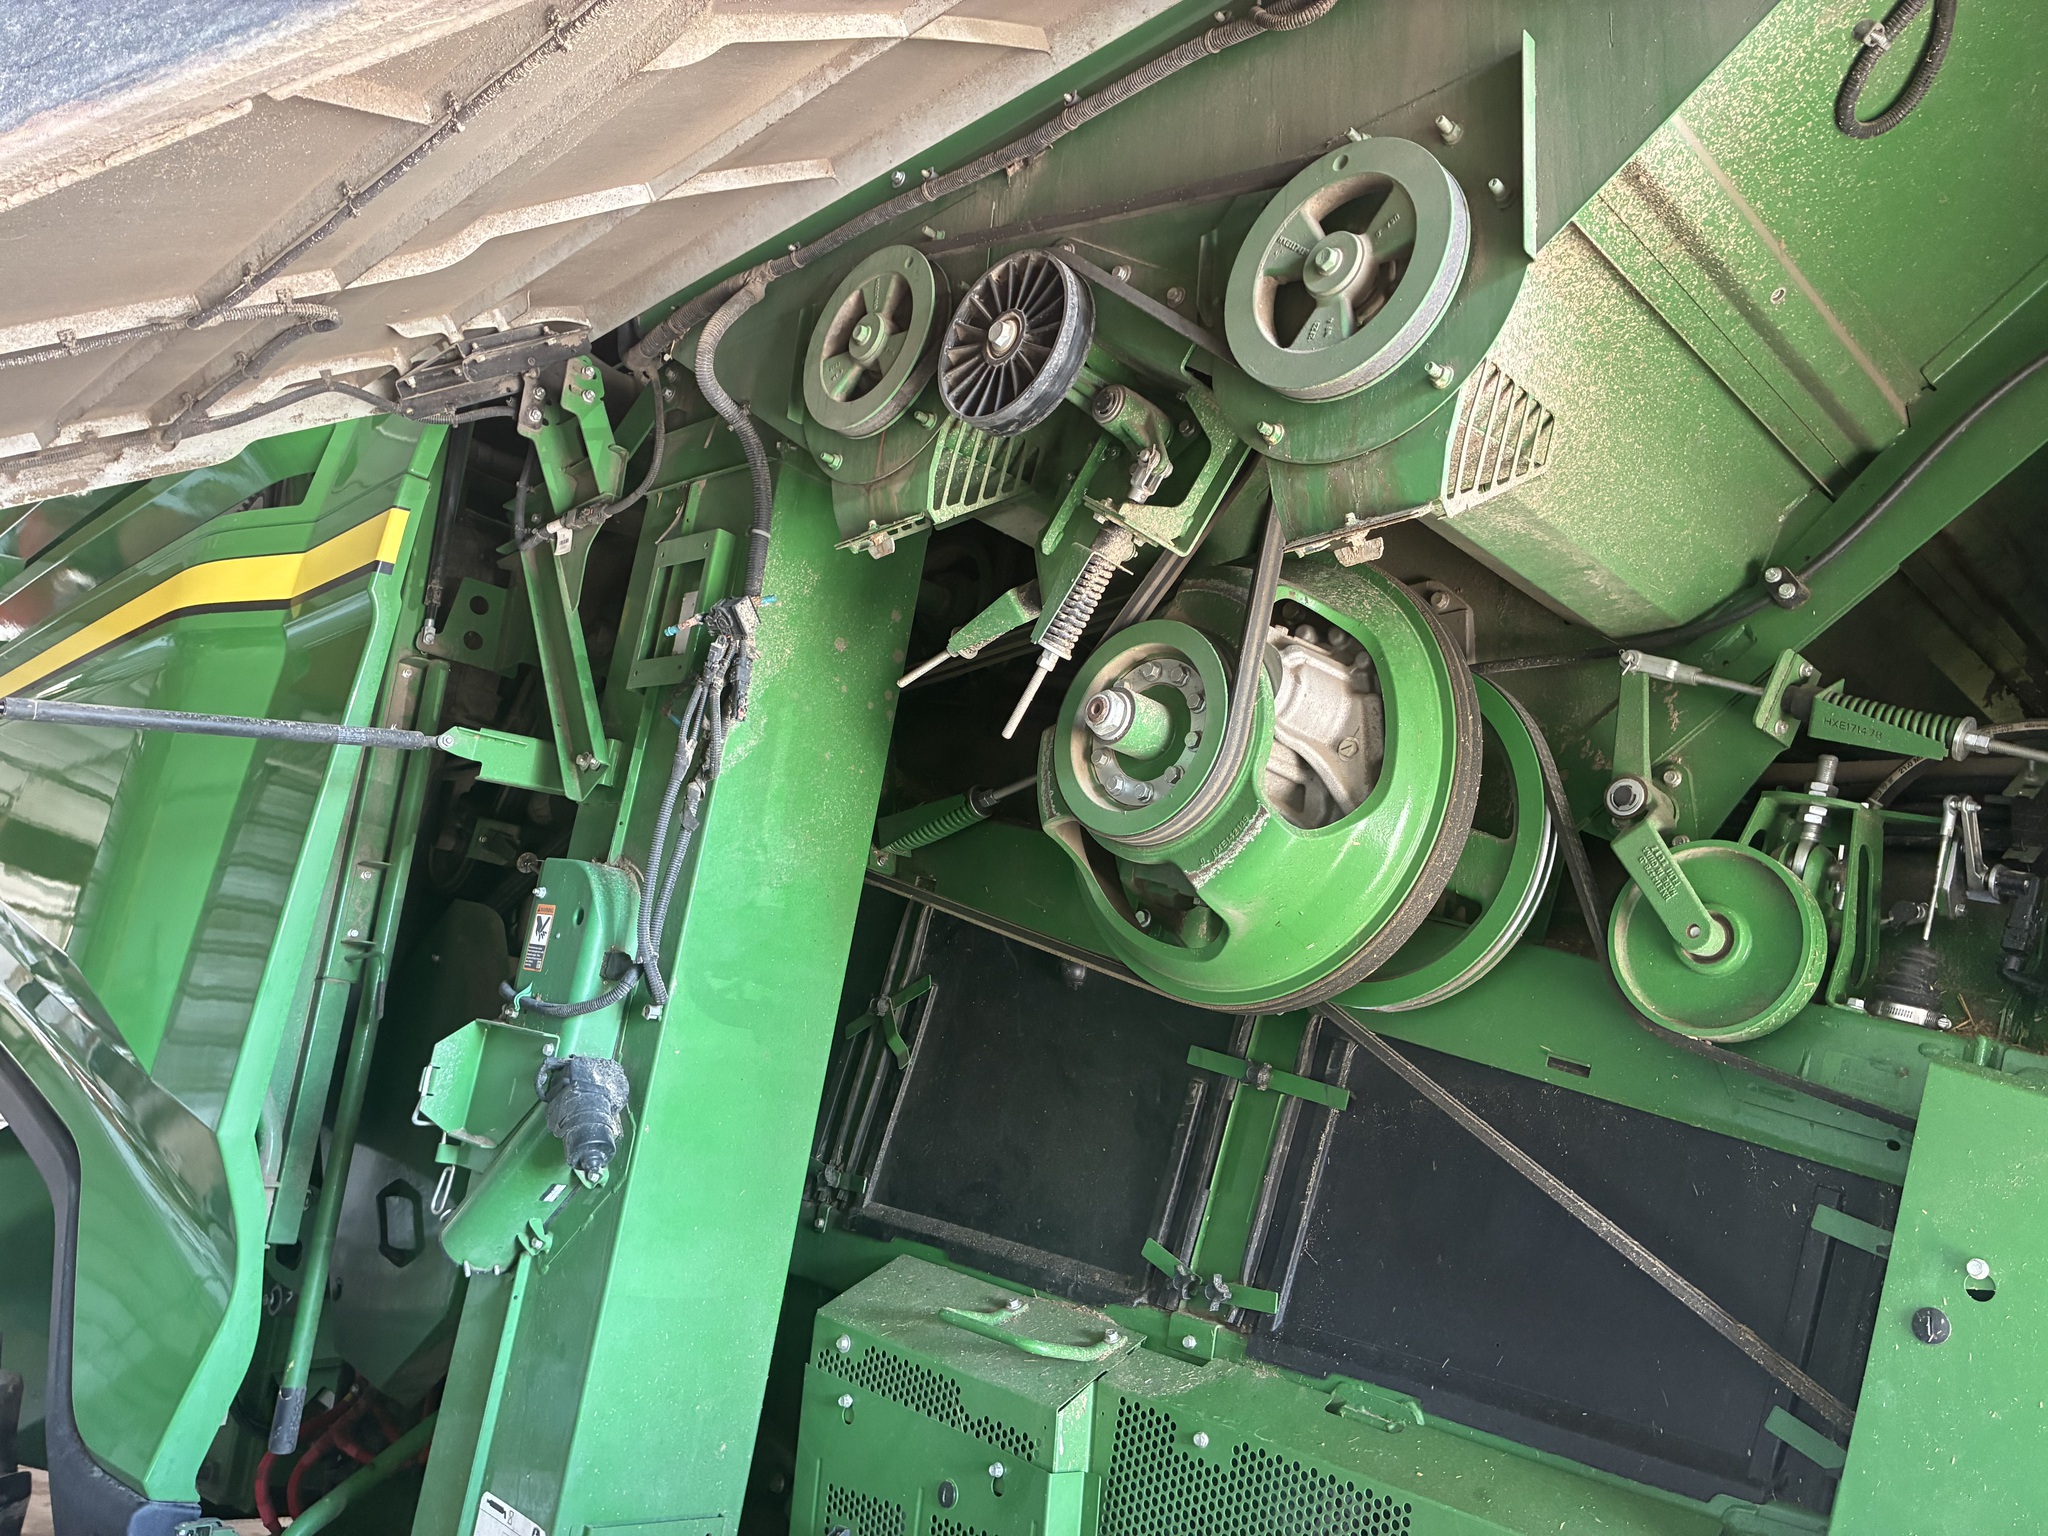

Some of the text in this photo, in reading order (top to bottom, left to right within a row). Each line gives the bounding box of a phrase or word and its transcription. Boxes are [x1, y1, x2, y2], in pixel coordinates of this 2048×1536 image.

[1642, 845, 1679, 898] MADE IN CHINA
